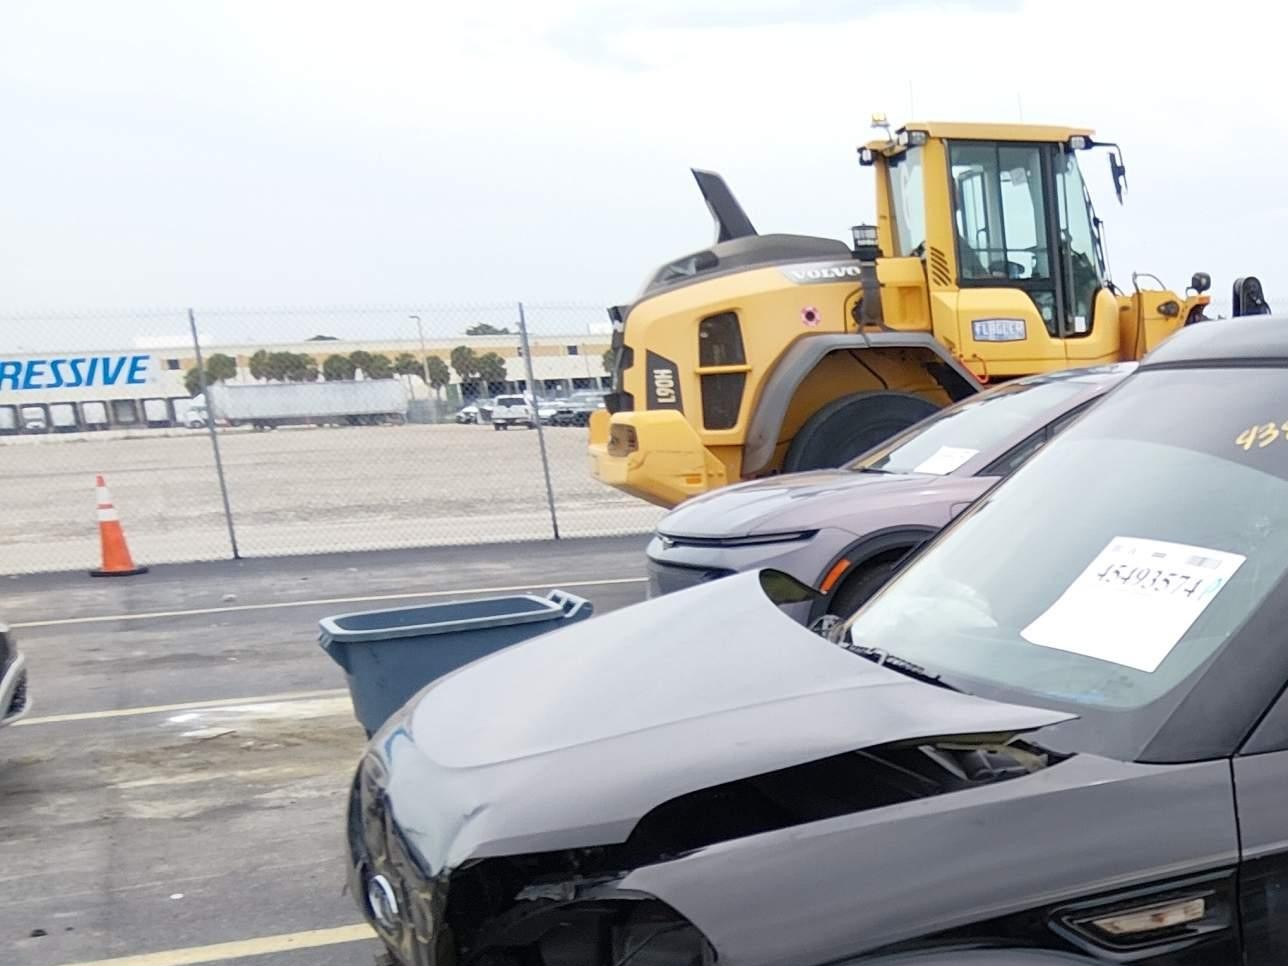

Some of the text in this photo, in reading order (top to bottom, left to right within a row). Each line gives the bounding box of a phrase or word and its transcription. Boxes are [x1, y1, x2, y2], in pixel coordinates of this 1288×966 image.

[790, 266, 861, 280] VOLVO
[653, 369, 677, 403] L90H
[1097, 564, 1204, 598] 45493574
